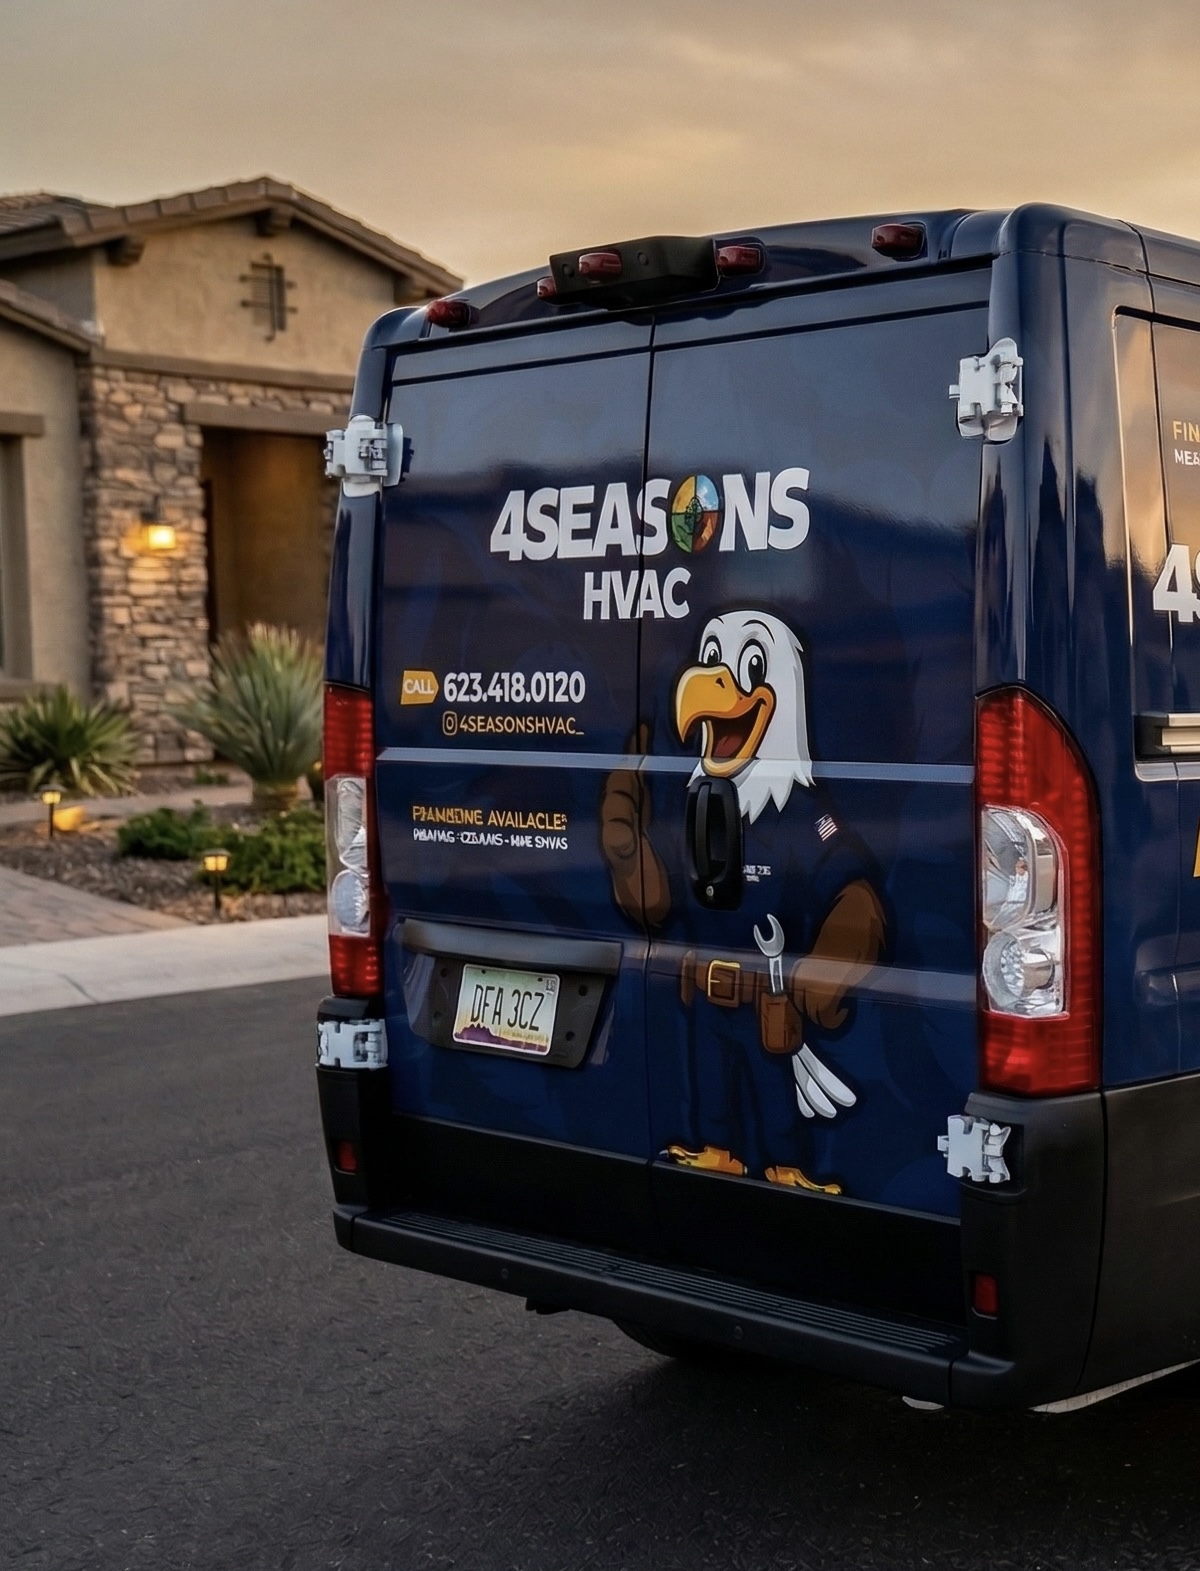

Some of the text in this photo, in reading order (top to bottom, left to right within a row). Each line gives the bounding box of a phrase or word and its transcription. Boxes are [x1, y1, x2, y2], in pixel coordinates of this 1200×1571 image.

[490, 467, 810, 561] 4SEASONS
[583, 567, 692, 620] HVAC
[403, 671, 586, 703] CALL 623.418.0120
[470, 984, 545, 1031] DFA 3CZ
